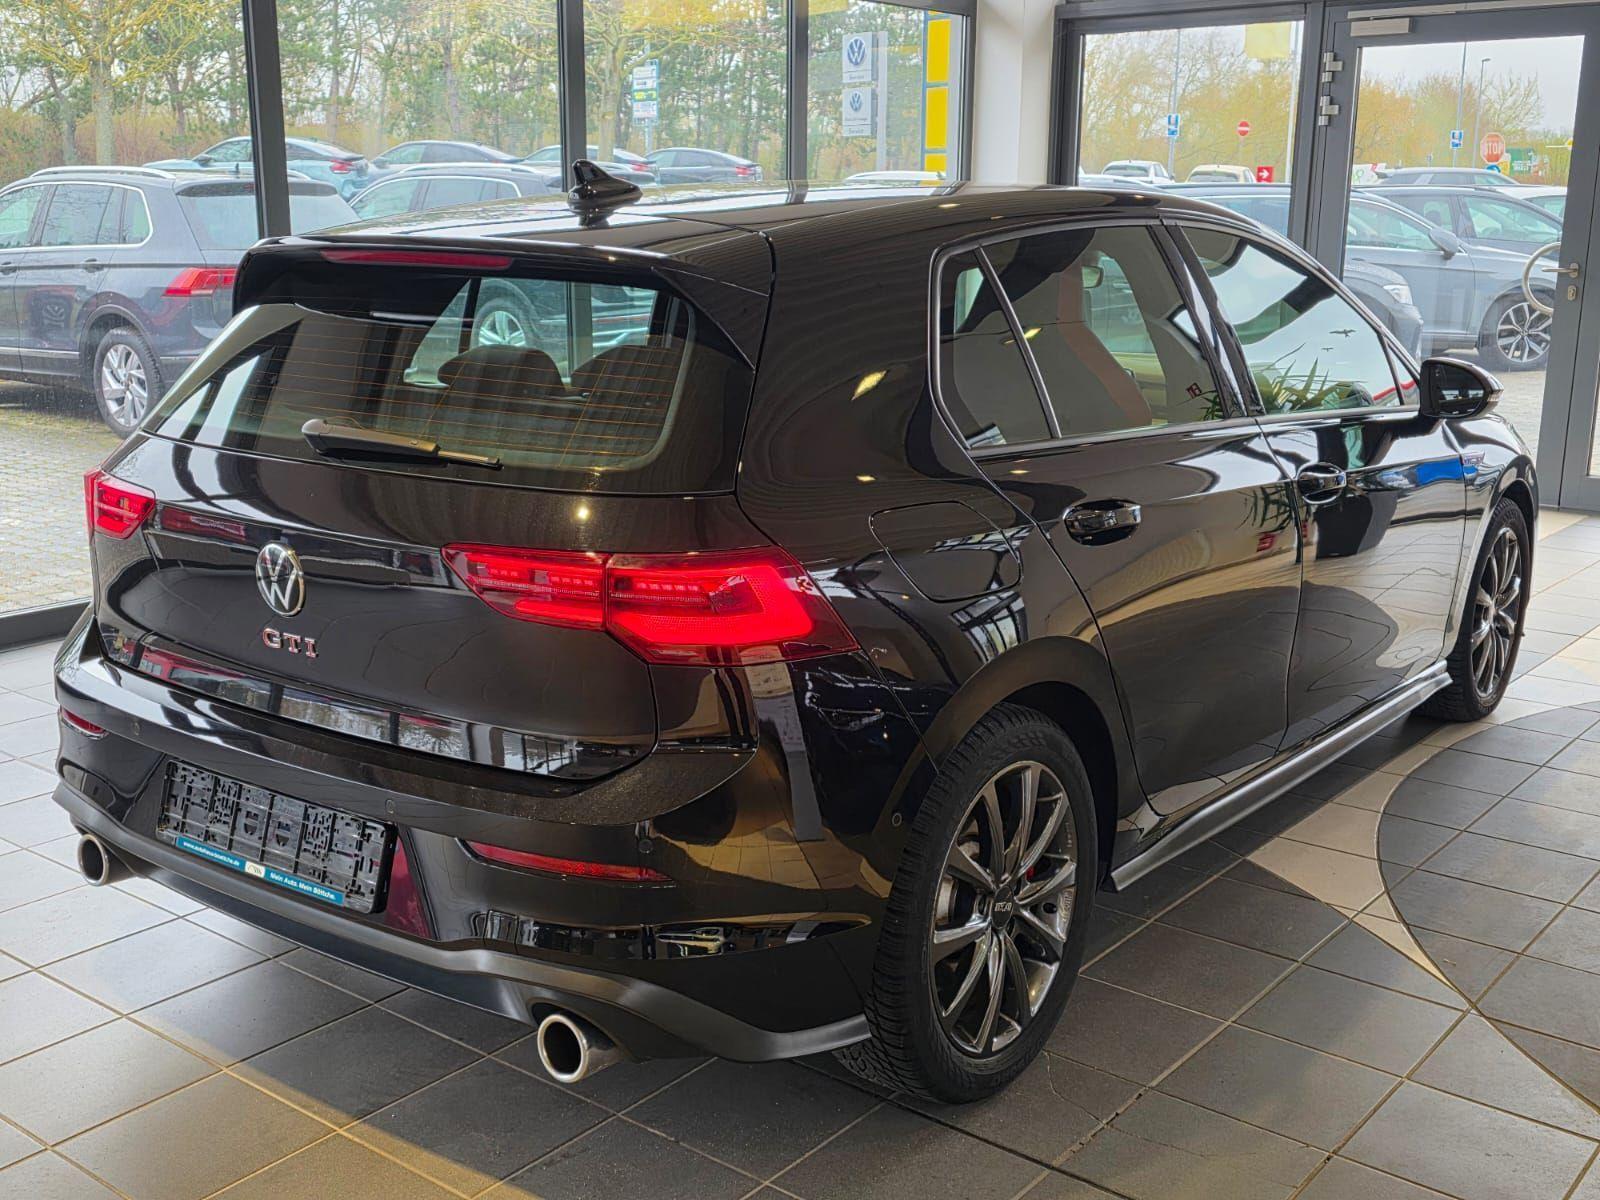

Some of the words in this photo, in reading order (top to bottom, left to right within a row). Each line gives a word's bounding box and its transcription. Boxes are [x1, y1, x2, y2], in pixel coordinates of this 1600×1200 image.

[1482, 142, 1503, 155] STOP
[262, 627, 319, 658] GTI
[270, 871, 283, 883] Mein
[298, 882, 312, 892] Mein
